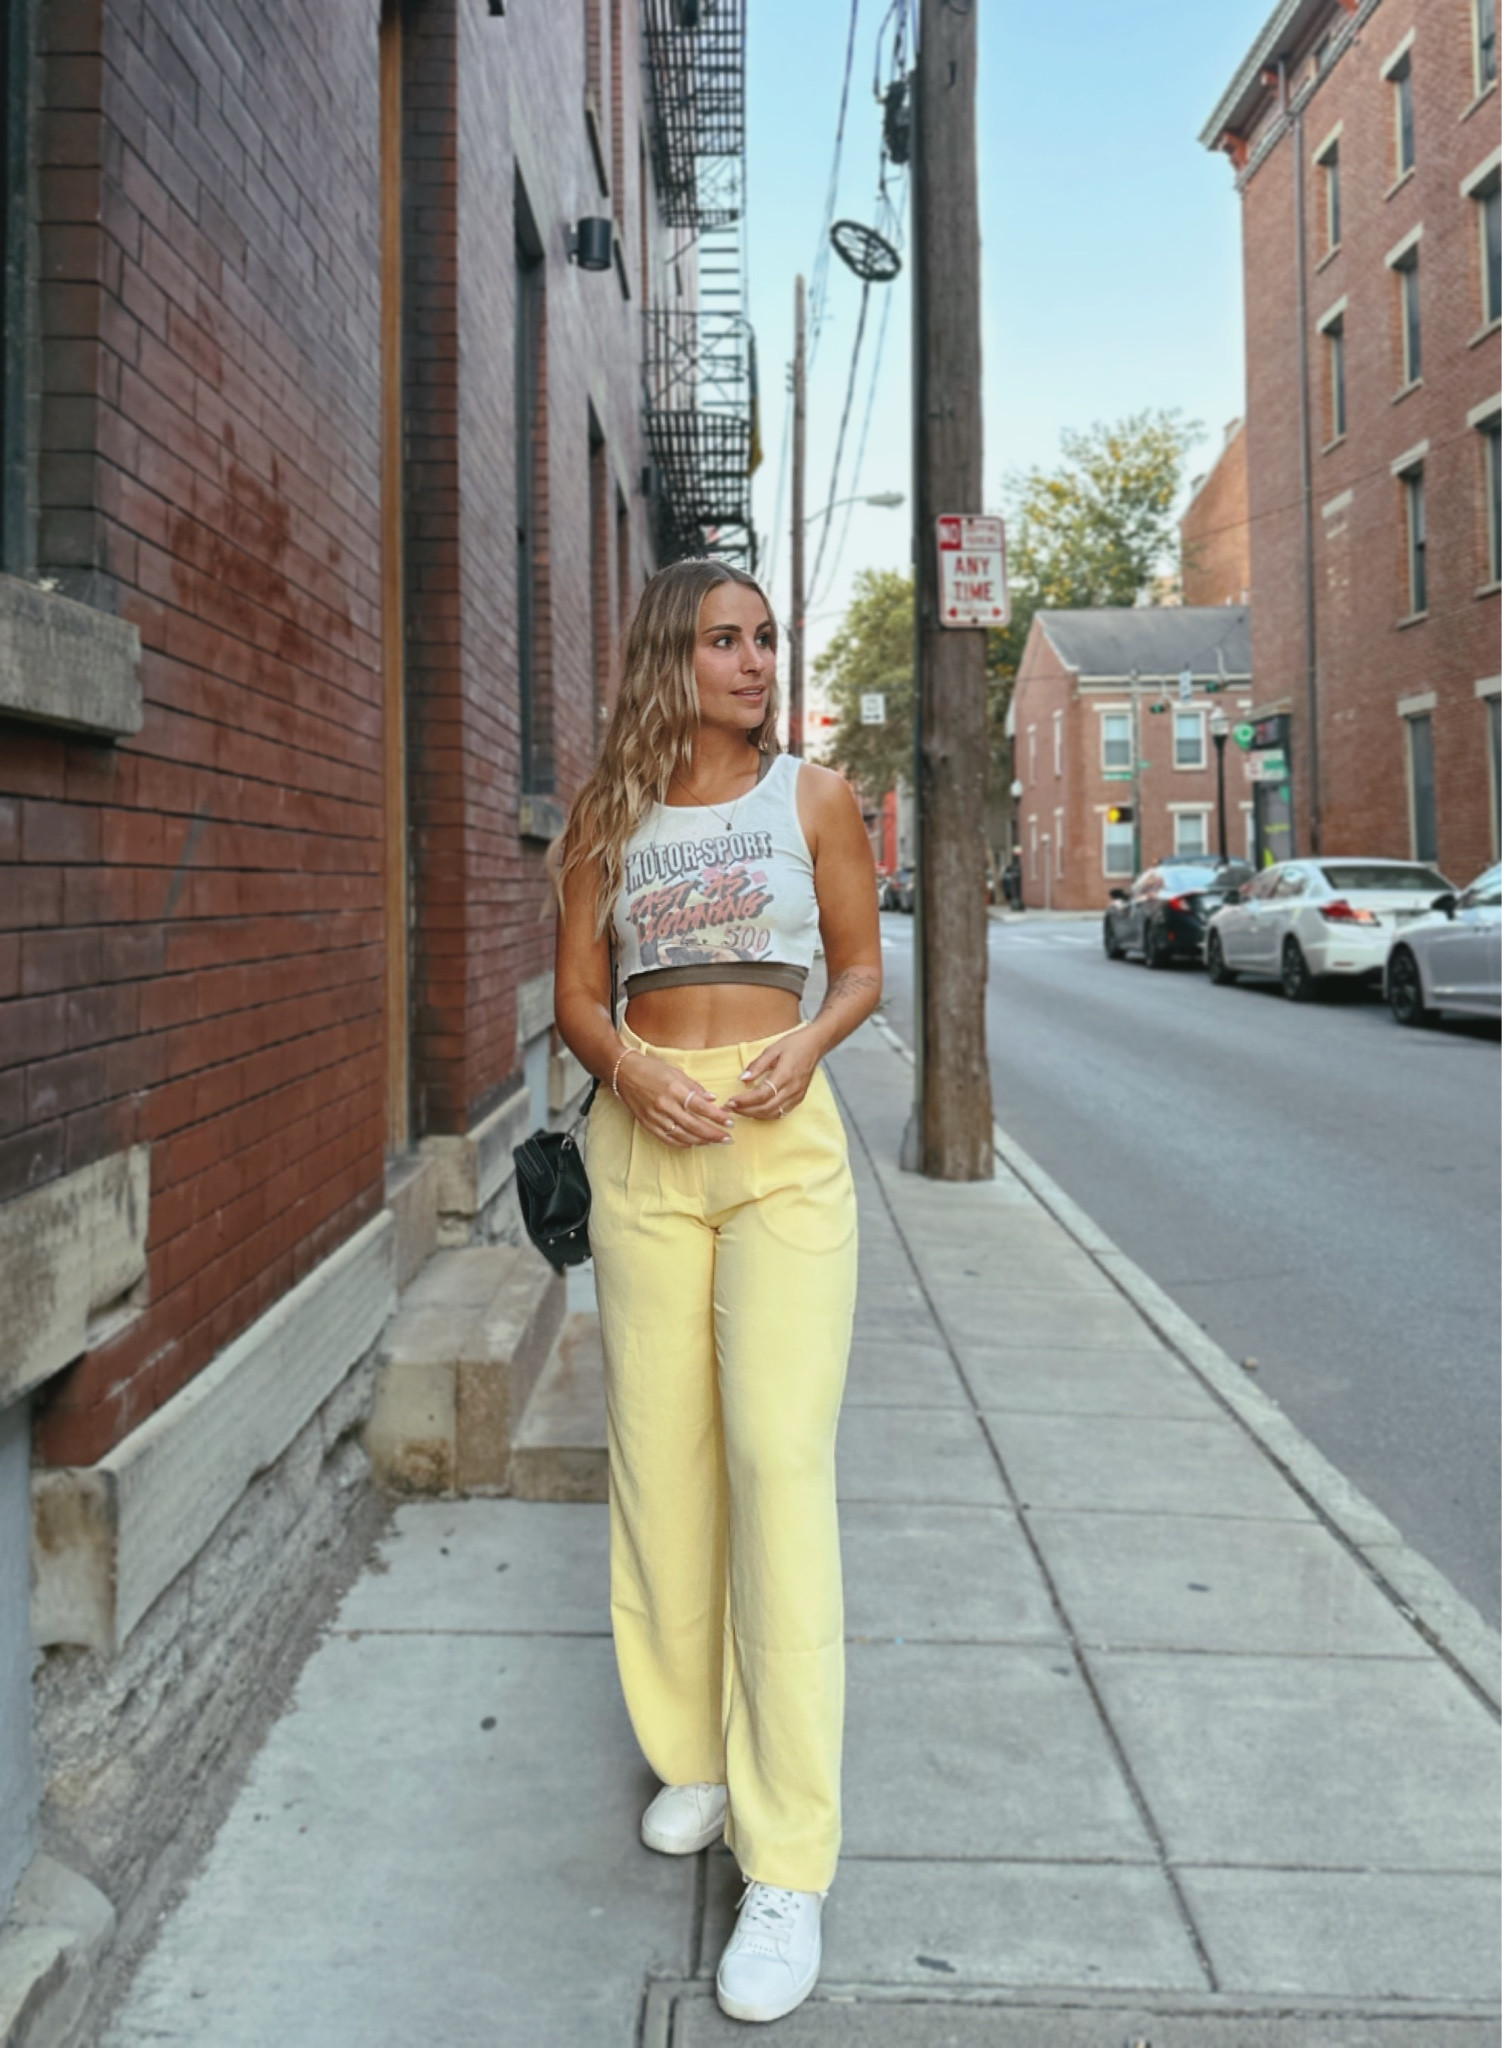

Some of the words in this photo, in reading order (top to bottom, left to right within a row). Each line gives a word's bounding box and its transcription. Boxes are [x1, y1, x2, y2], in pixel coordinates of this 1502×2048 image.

[954, 556, 990, 575] ANY
[952, 581, 994, 601] TIME
[722, 924, 771, 952] 500
